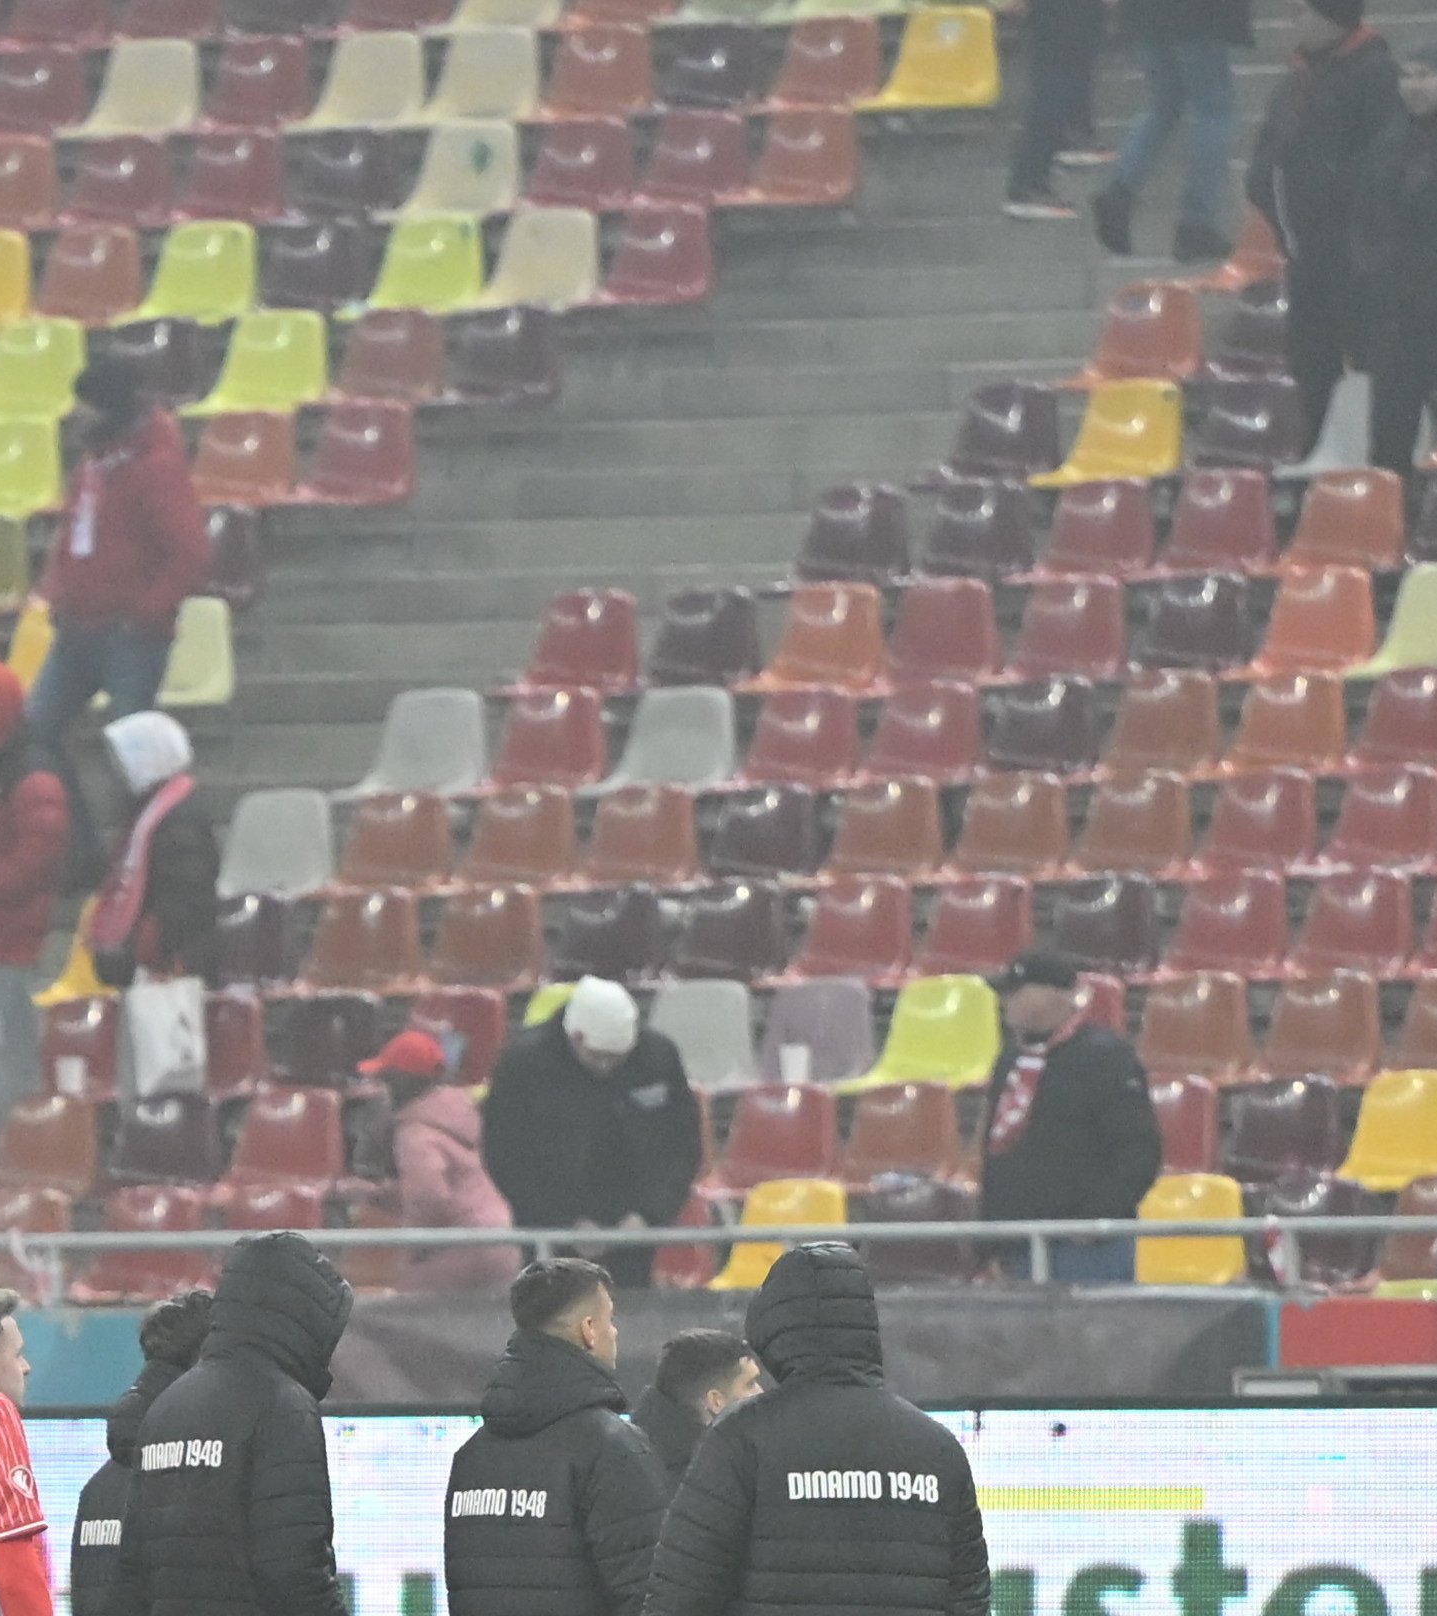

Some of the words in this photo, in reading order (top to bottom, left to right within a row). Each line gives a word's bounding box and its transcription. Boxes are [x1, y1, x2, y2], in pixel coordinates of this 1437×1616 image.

[185, 1438, 224, 1468] 1948
[787, 1470, 883, 1500] DINAMO
[887, 1471, 940, 1504] 1948
[451, 1488, 508, 1518] DINAMO
[510, 1488, 548, 1519] 1948
[79, 1519, 123, 1546] DINAM
